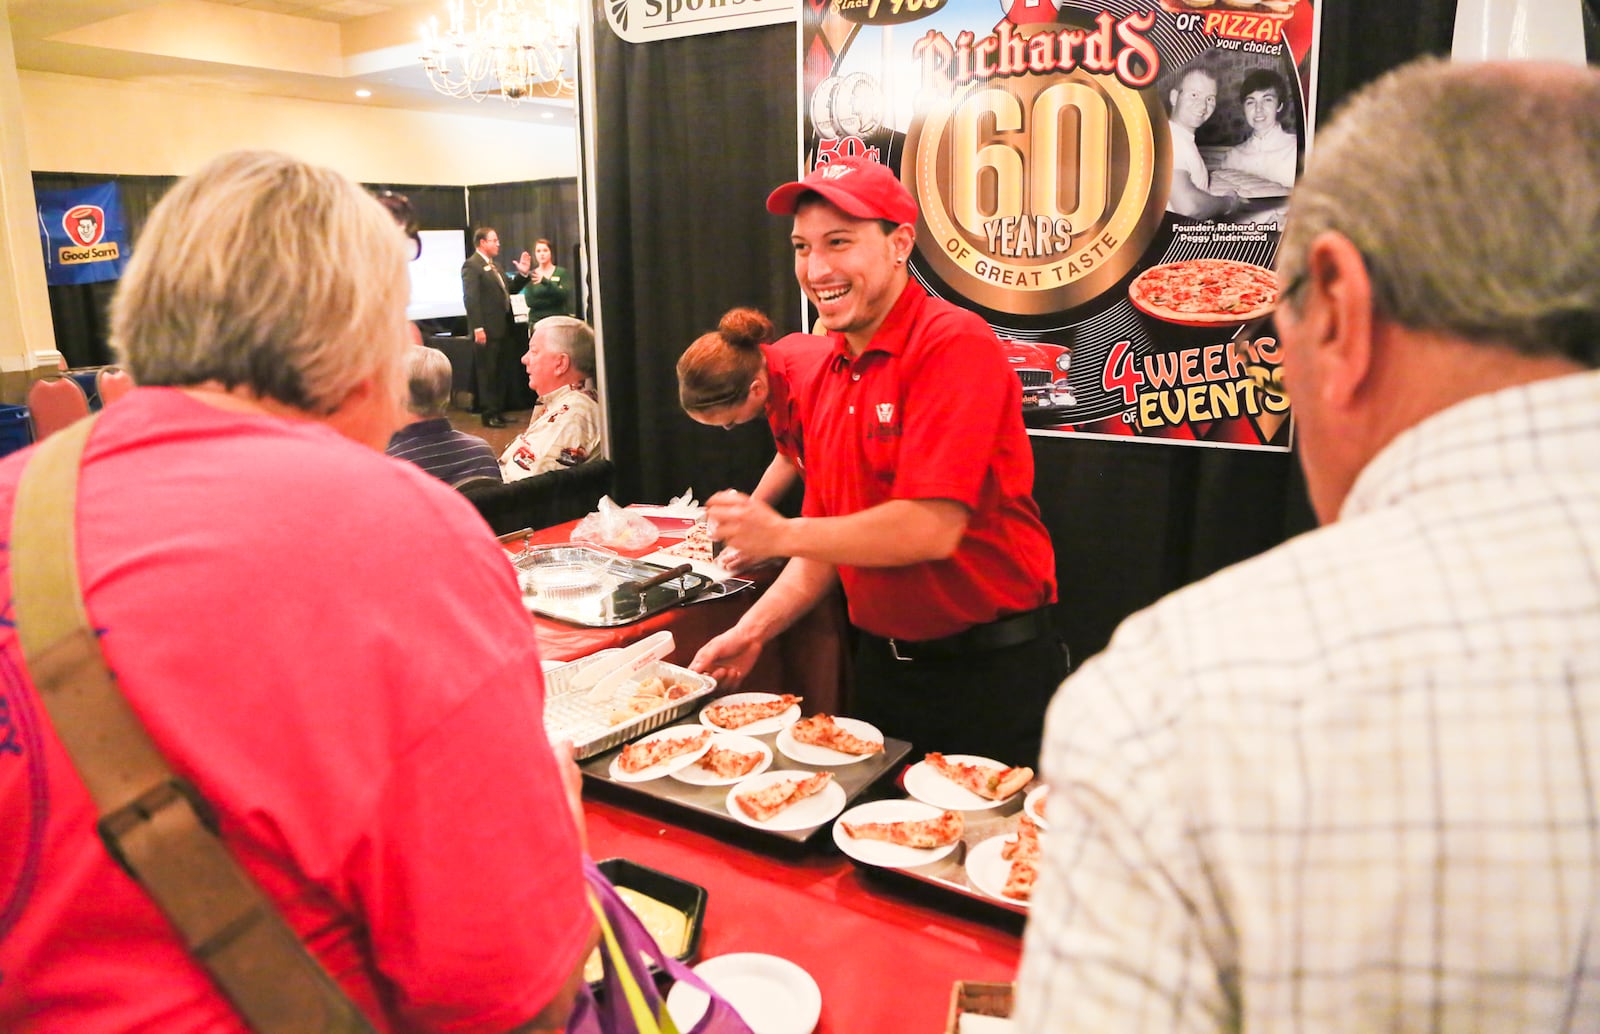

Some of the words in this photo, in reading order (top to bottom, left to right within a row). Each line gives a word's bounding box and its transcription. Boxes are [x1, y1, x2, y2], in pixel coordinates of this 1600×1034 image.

[1176, 13, 1200, 31] or
[1205, 12, 1283, 41] PIZZA!
[1216, 37, 1241, 50] your
[1243, 40, 1283, 55] choice!
[952, 82, 1109, 237] 60
[984, 214, 1073, 259] YEARS
[1180, 233, 1210, 243] Peggy
[1212, 233, 1268, 241] Underwood
[1217, 222, 1255, 232] Richard
[1256, 222, 1277, 231] and
[62, 249, 90, 260] Good
[93, 247, 116, 257] Sam
[946, 238, 971, 260] OF
[975, 260, 1042, 286] GREAT
[1052, 231, 1118, 282] TASTE
[1102, 340, 1146, 406] 4
[1122, 411, 1138, 424] OF
